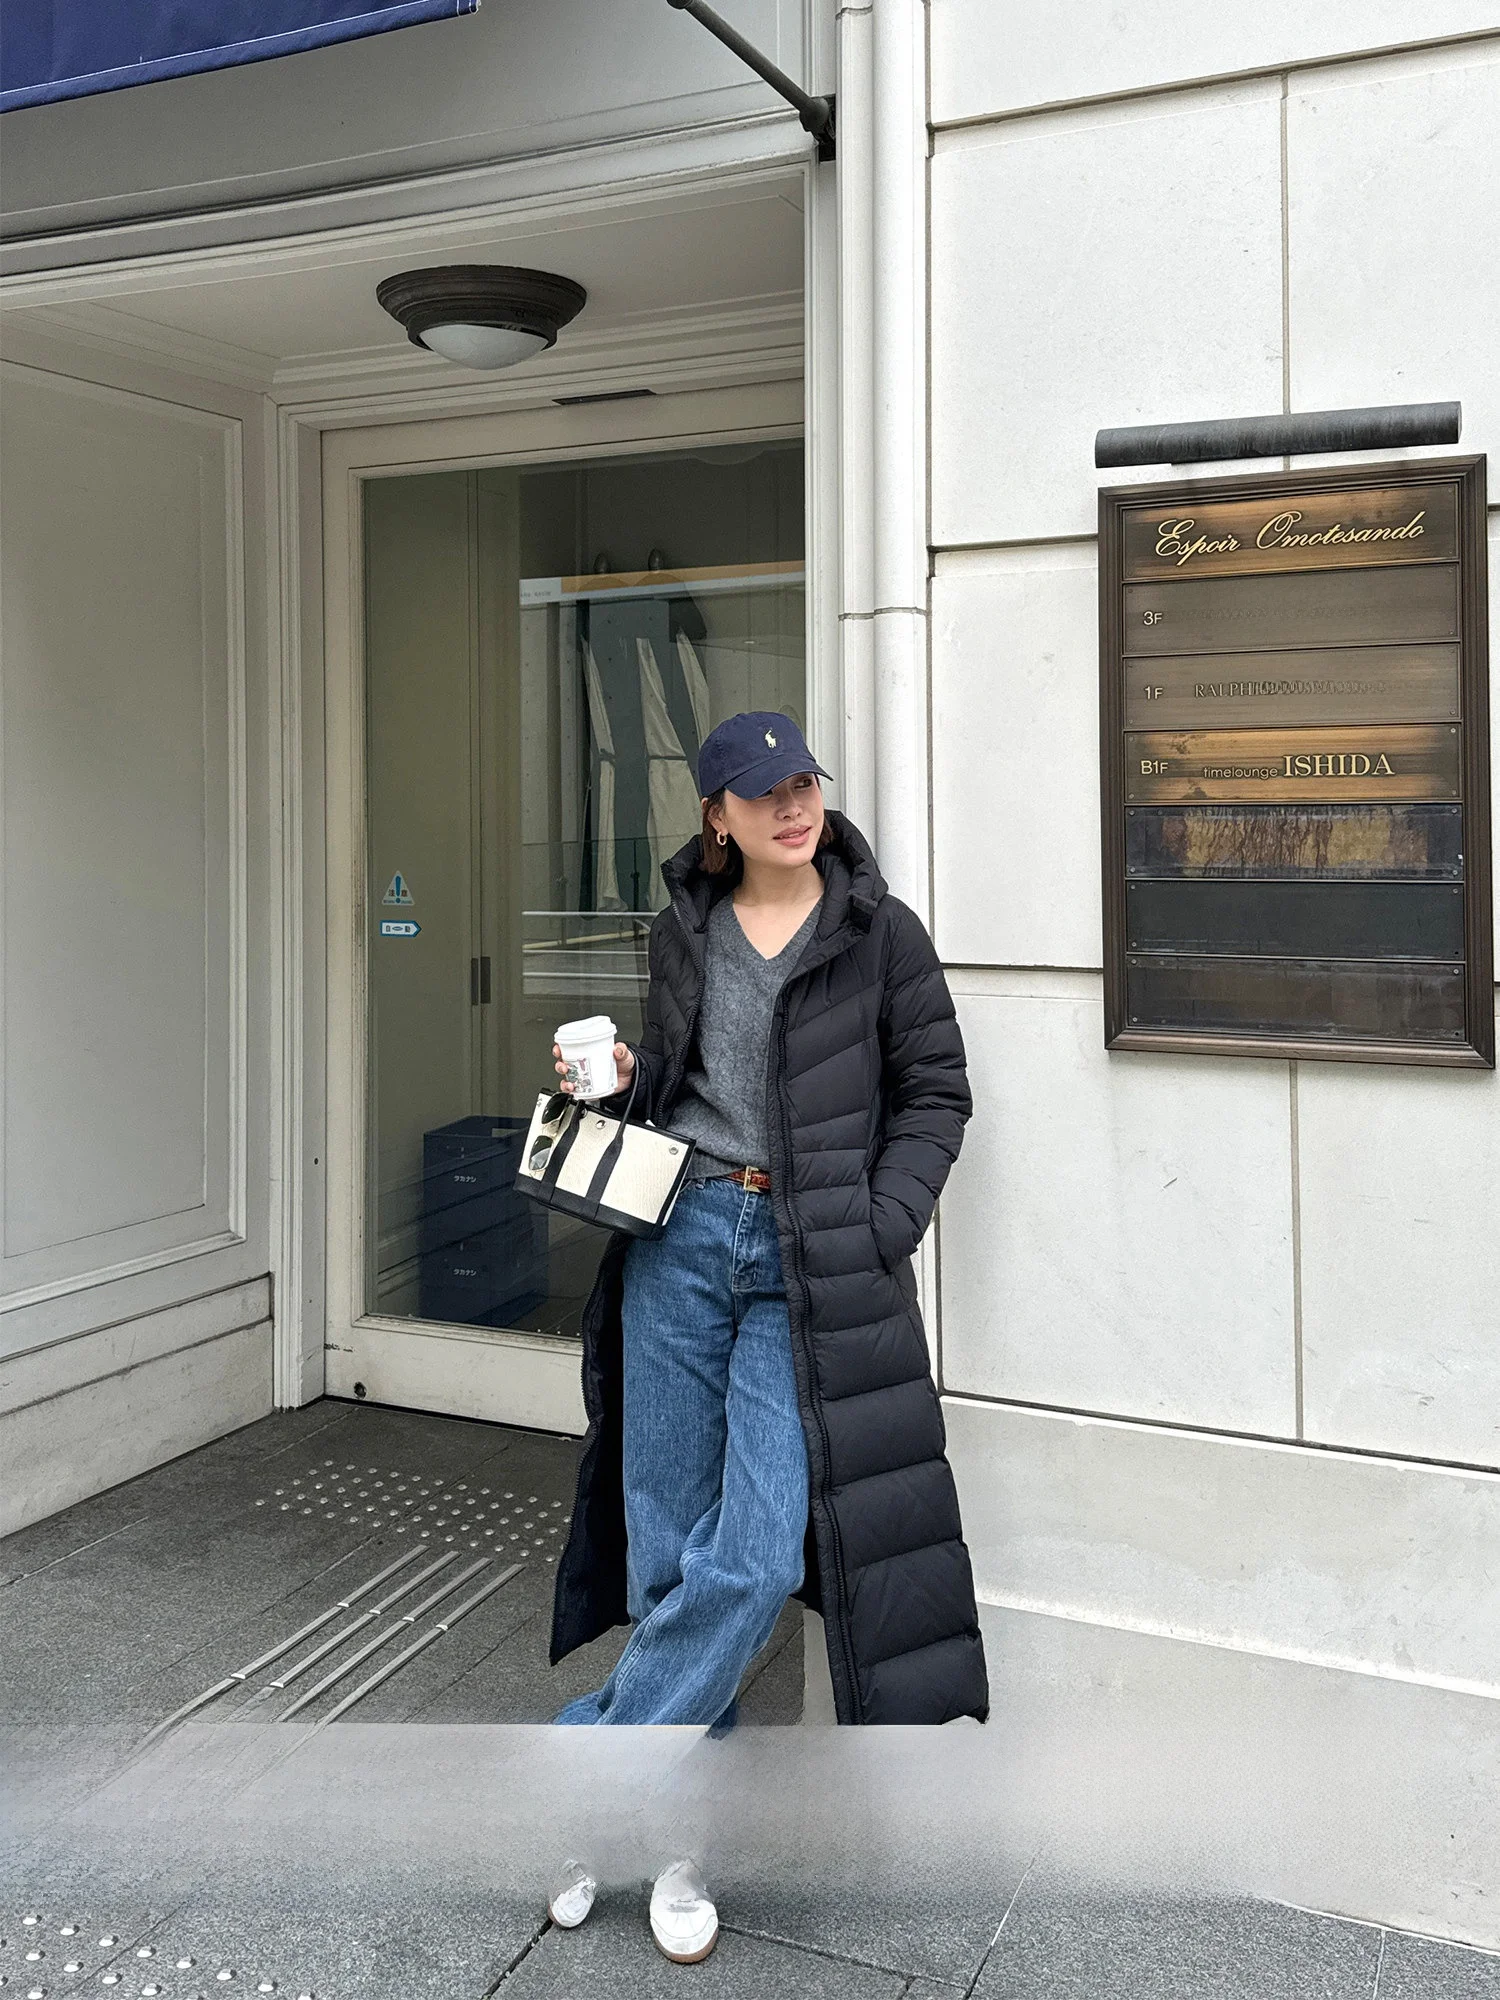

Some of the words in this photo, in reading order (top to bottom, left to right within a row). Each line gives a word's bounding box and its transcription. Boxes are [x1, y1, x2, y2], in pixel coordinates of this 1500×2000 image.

[1155, 519, 1241, 566] Espoir
[1255, 510, 1426, 549] Omotesando
[1143, 611, 1163, 626] 3F
[1143, 685, 1164, 700] 1F
[1140, 760, 1169, 775] B1F
[1203, 765, 1278, 780] timelounge
[1282, 754, 1396, 777] ISHIDA
